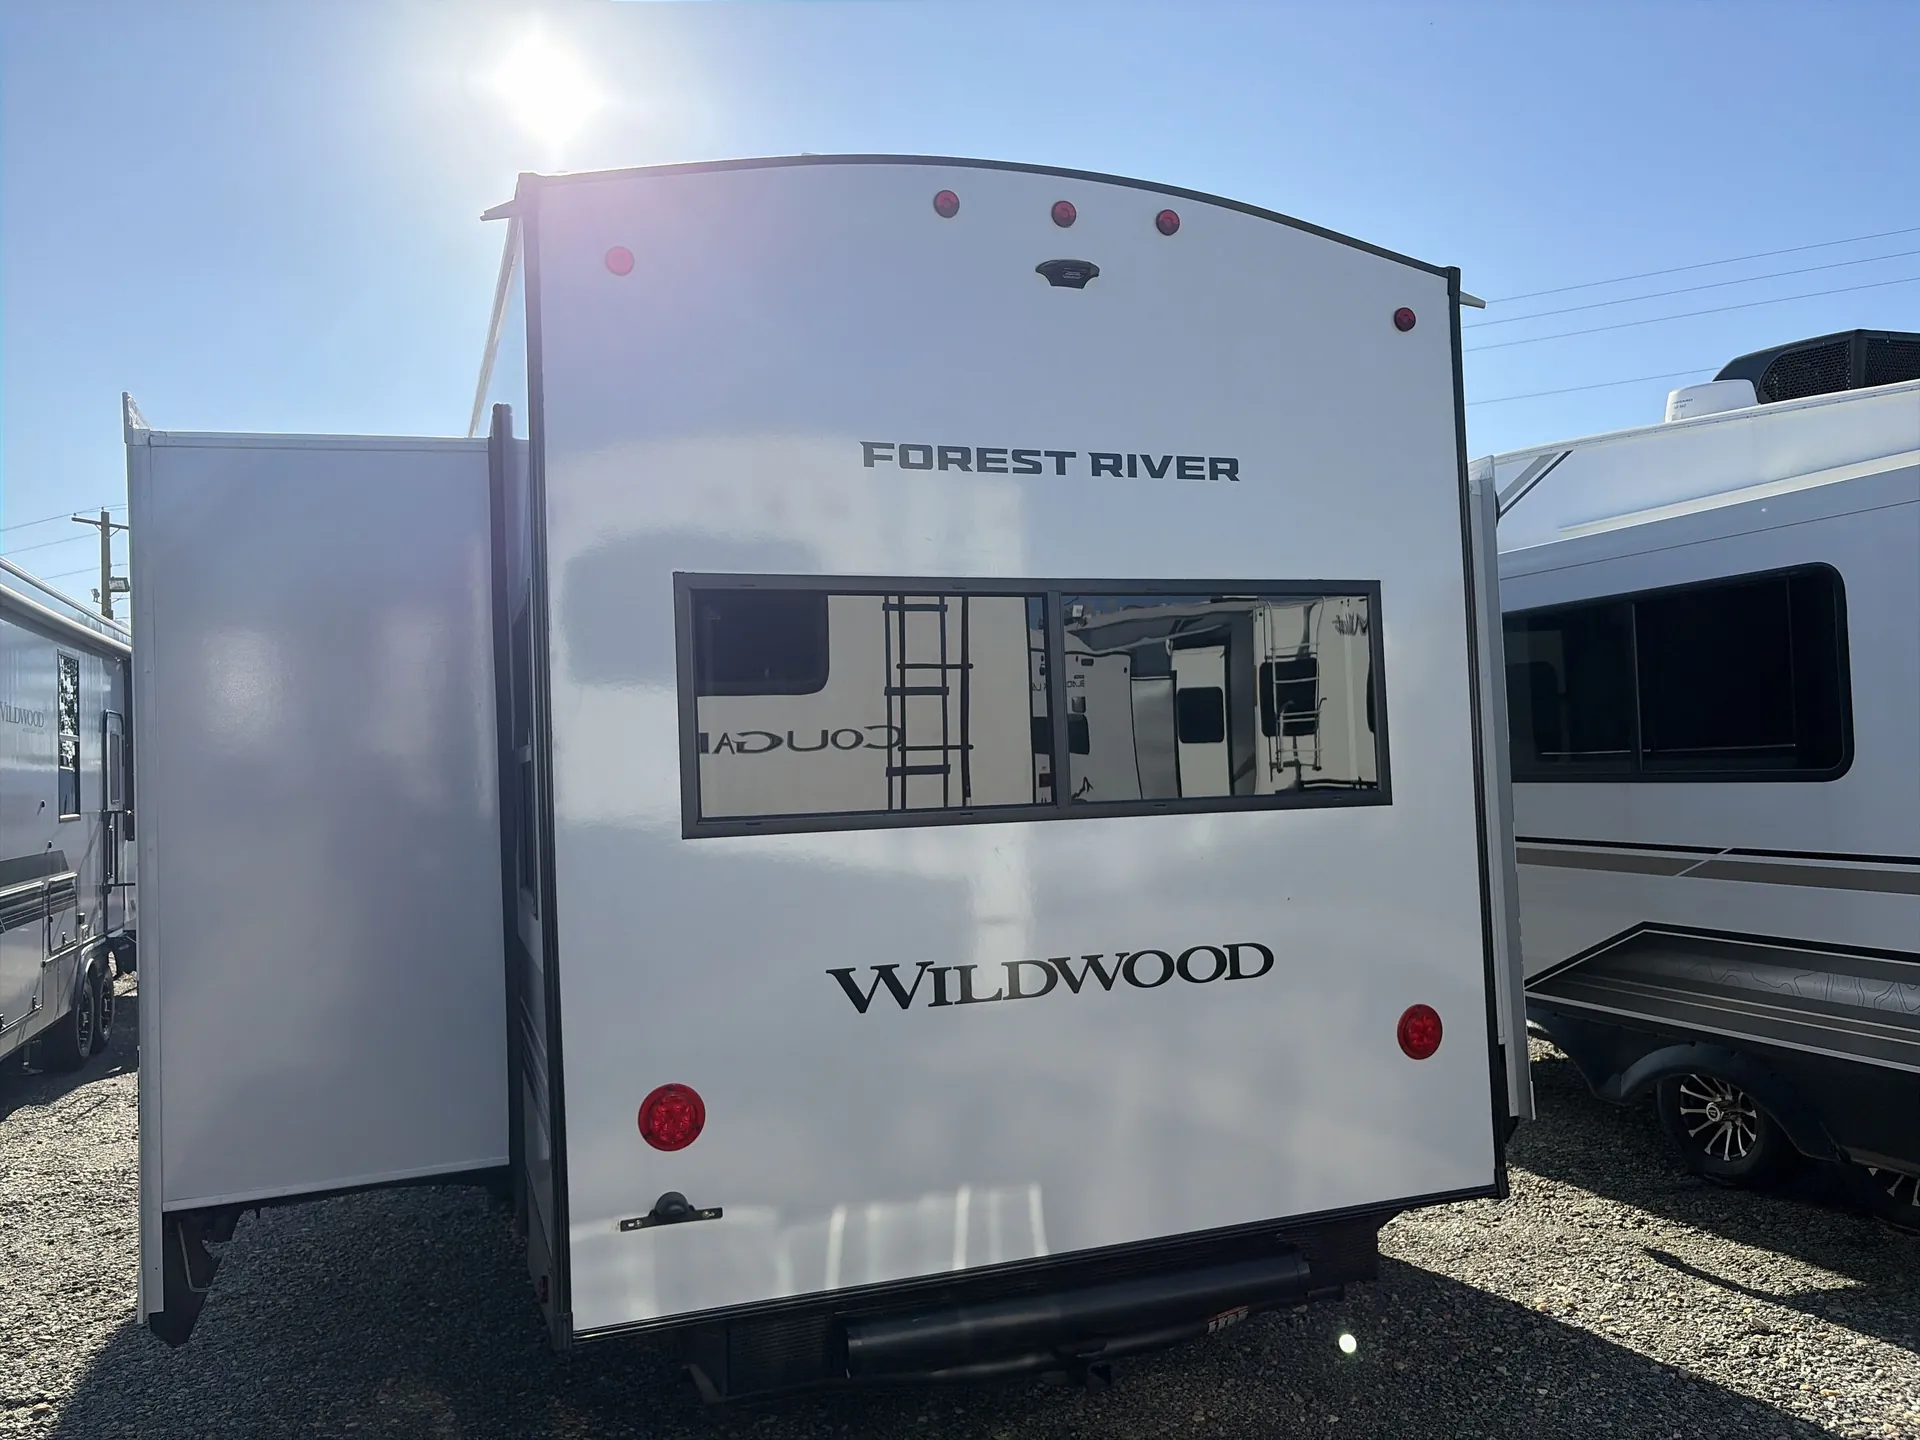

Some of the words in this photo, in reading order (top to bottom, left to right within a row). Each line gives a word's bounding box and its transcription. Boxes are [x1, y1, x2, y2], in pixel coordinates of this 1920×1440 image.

[860, 441, 1076, 475] FOREST
[1088, 452, 1240, 481] RIVER
[826, 942, 1274, 1014] WILDWOOD
